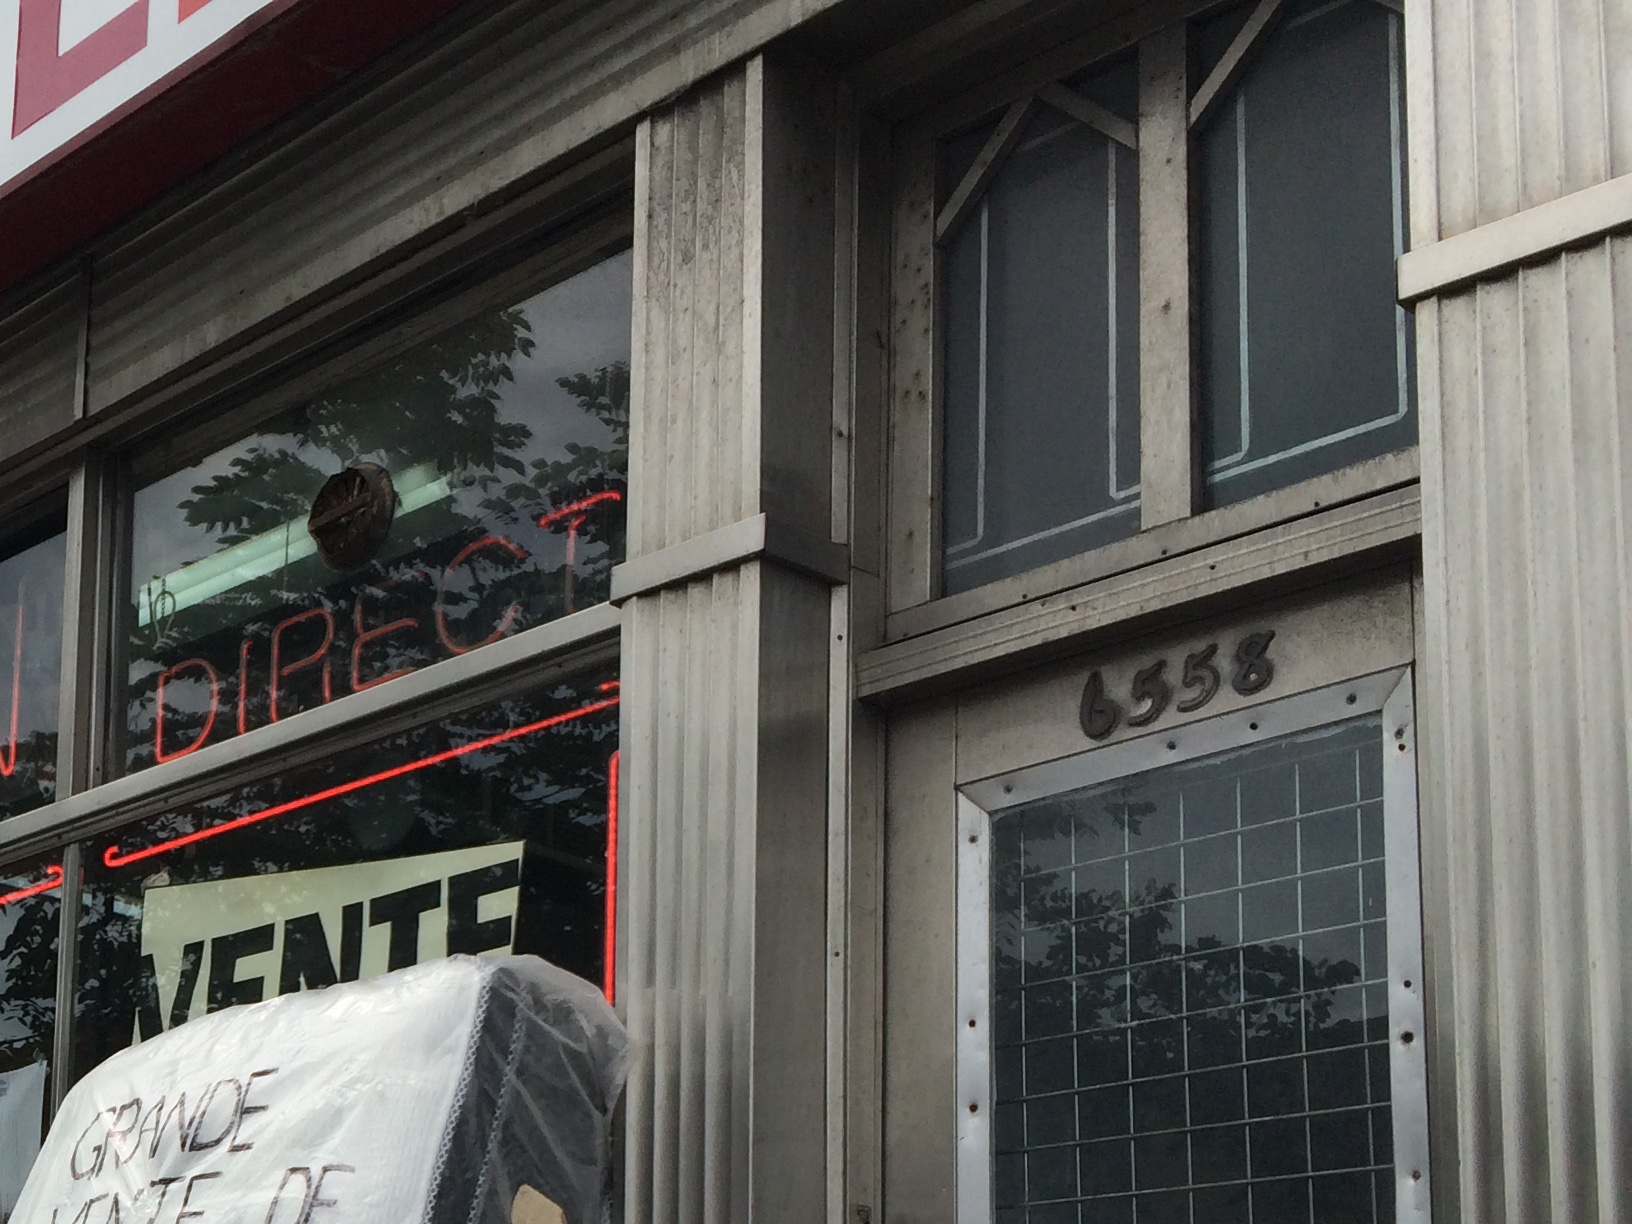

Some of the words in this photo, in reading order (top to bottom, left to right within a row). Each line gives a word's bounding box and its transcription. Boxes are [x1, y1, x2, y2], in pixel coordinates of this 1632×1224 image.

[155, 490, 622, 764] DIRECT
[1079, 630, 1276, 740] 6558
[134, 858, 521, 1040] VENTE
[69, 1067, 280, 1182] GRANDE
